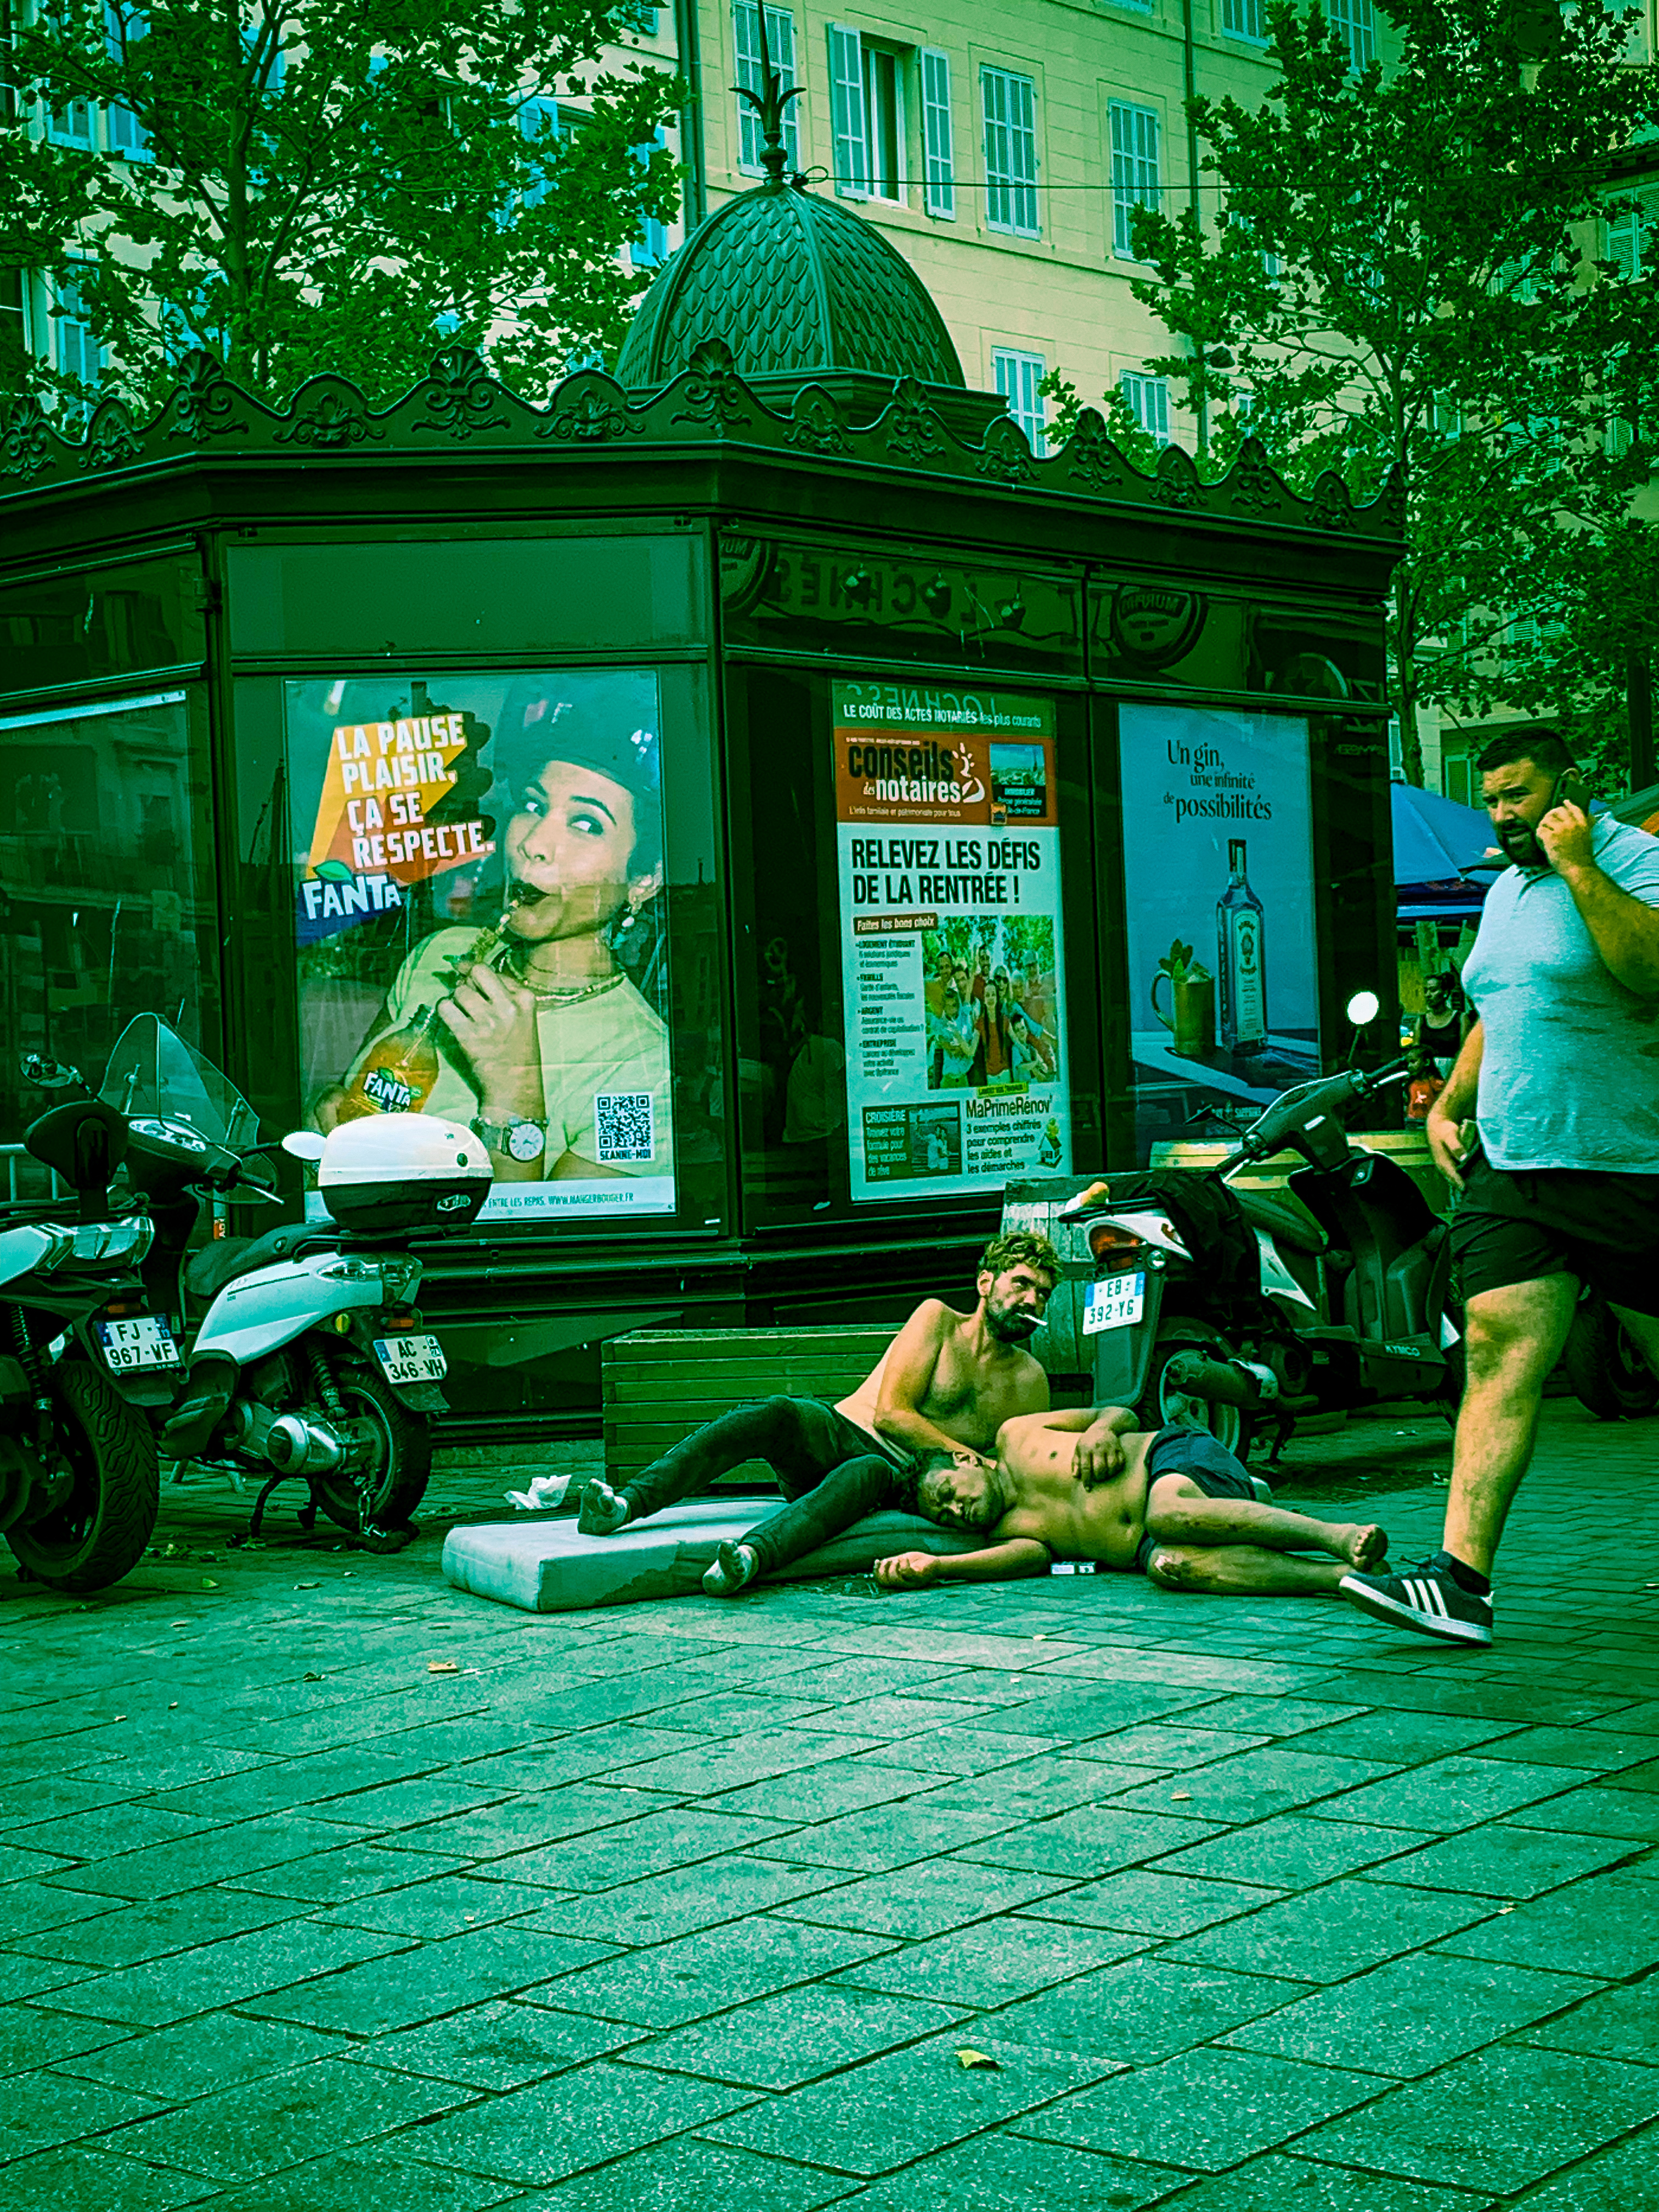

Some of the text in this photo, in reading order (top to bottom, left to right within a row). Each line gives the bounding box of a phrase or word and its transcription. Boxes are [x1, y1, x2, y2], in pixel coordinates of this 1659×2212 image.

[844, 704, 856, 718] LE
[859, 703, 884, 719] COÛT
[887, 706, 902, 720] DES
[905, 708, 932, 722] ACTES
[934, 709, 977, 724] NOTARIÉS
[994, 713, 1011, 727] plus
[1012, 715, 1041, 728] courants
[337, 714, 466, 760] LA PAUSE
[849, 741, 955, 781] conseils
[1167, 740, 1225, 773] Un gin,
[342, 752, 458, 794] PLAISIR,
[1190, 771, 1256, 790] une infinité
[863, 775, 961, 803] des notaires
[347, 792, 424, 836] ÇA SE
[1163, 791, 1272, 823] de possibilités
[352, 821, 496, 868] RESPECTE.
[851, 837, 1041, 871] RELEVEZ LES DÉFIS
[853, 872, 1020, 904] DE LA RENTRÉE !
[857, 916, 934, 931] Faites les bons choix
[866, 1108, 906, 1124] CROISIÈRE
[966, 1093, 1053, 1118] MaPrimeRénov'
[973, 1122, 1011, 1134] exemples
[1012, 1119, 1042, 1131] chiffrés
[967, 1133, 1035, 1149] pour comprendre
[600, 1148, 651, 1161] SCANNE-MOI
[967, 1148, 1012, 1161] les aides et
[967, 1160, 1025, 1173] les démarches
